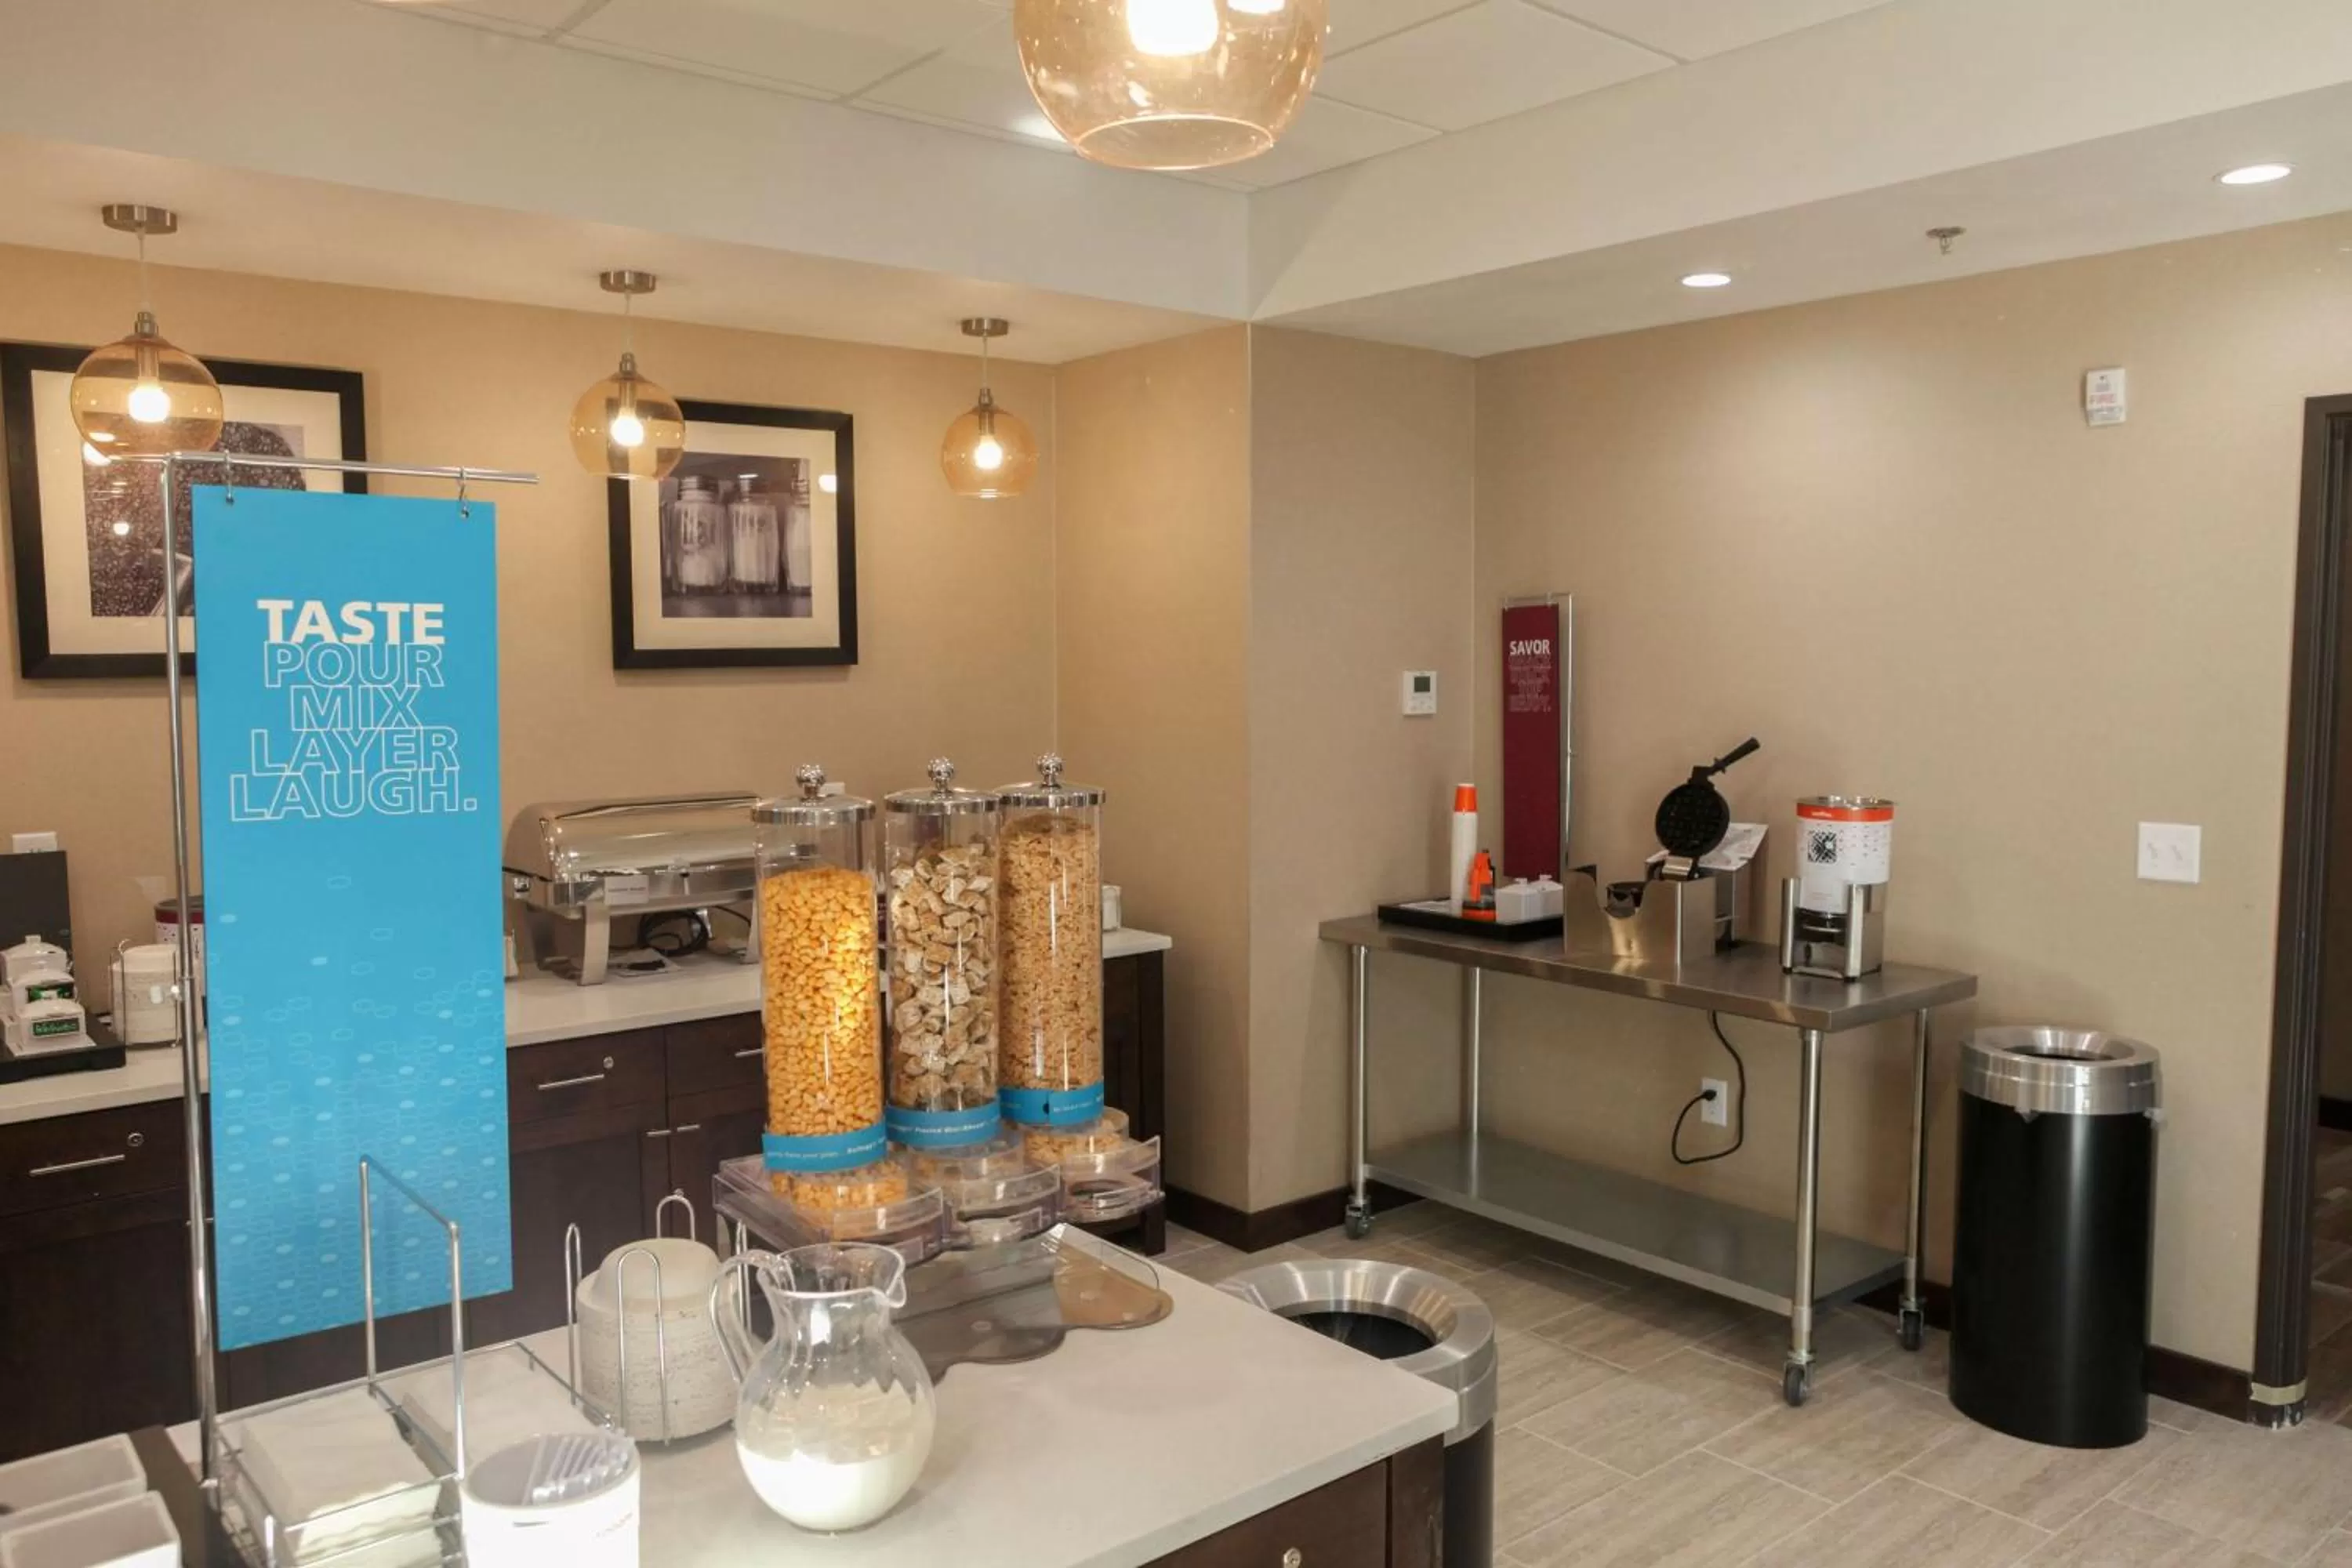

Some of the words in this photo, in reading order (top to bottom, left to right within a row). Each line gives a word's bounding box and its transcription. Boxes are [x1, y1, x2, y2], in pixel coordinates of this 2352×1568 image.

[256, 599, 445, 645] TASTE
[263, 641, 445, 688] POUR
[1509, 639, 1551, 655] SAVOR
[290, 684, 422, 731] MIX
[251, 726, 460, 777] LAYER
[230, 768, 478, 822] LAUGH.
